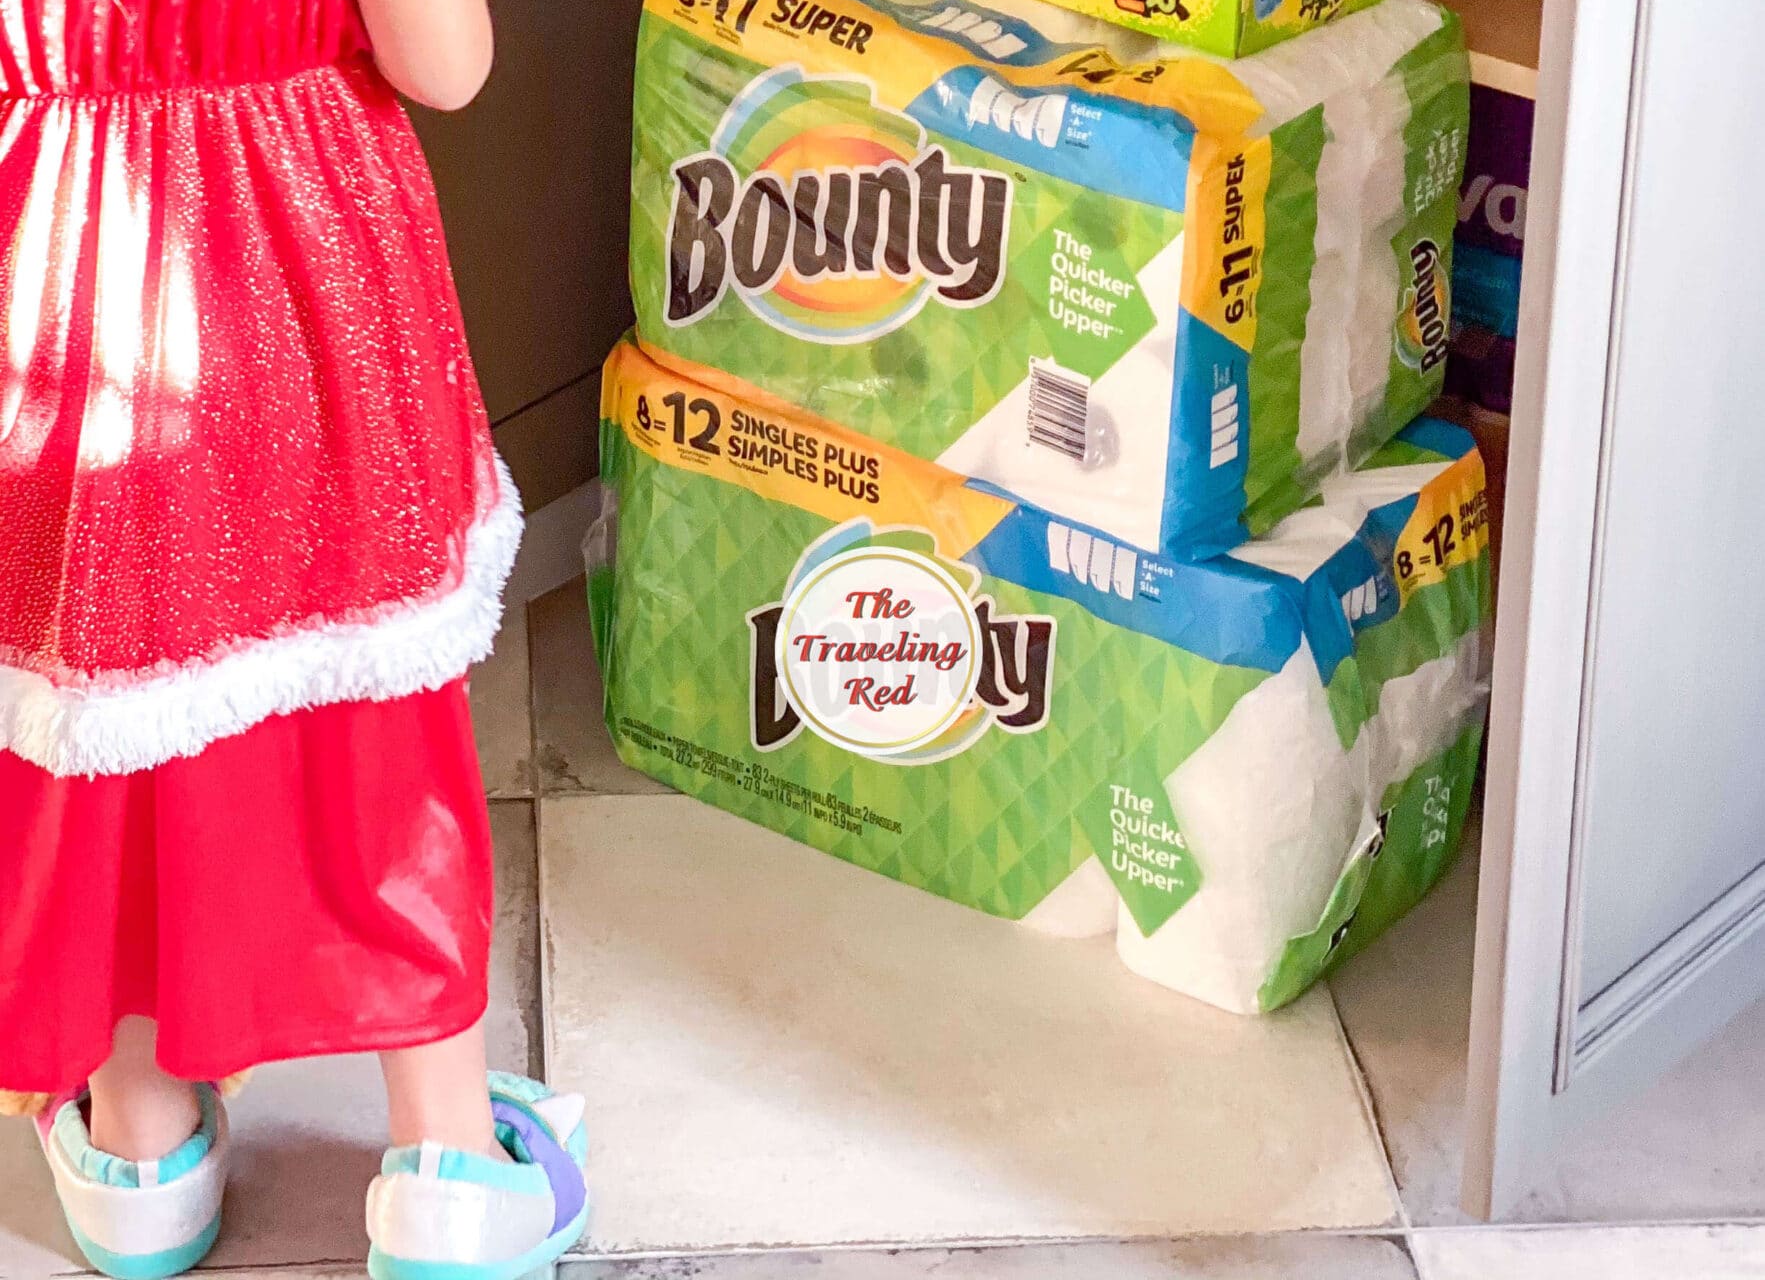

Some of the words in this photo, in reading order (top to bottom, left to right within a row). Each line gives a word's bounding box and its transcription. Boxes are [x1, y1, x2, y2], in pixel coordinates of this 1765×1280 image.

[1070, 104, 1102, 121] Select
[667, 147, 1008, 322] Bounty
[1053, 228, 1093, 262] The
[1049, 275, 1117, 317] Picker
[1051, 252, 1135, 300] Quicker
[1048, 298, 1113, 340] Upper
[1409, 239, 1449, 375] Bounty
[730, 409, 818, 459] SINGLES
[823, 443, 879, 479] PLUS
[727, 435, 818, 483] SIMPLES
[823, 468, 880, 504] PLUS
[1139, 581, 1160, 596] Size
[1142, 559, 1174, 578] Select
[1109, 784, 1154, 814] The
[1112, 828, 1181, 869] Picker
[1111, 850, 1176, 893] Upper
